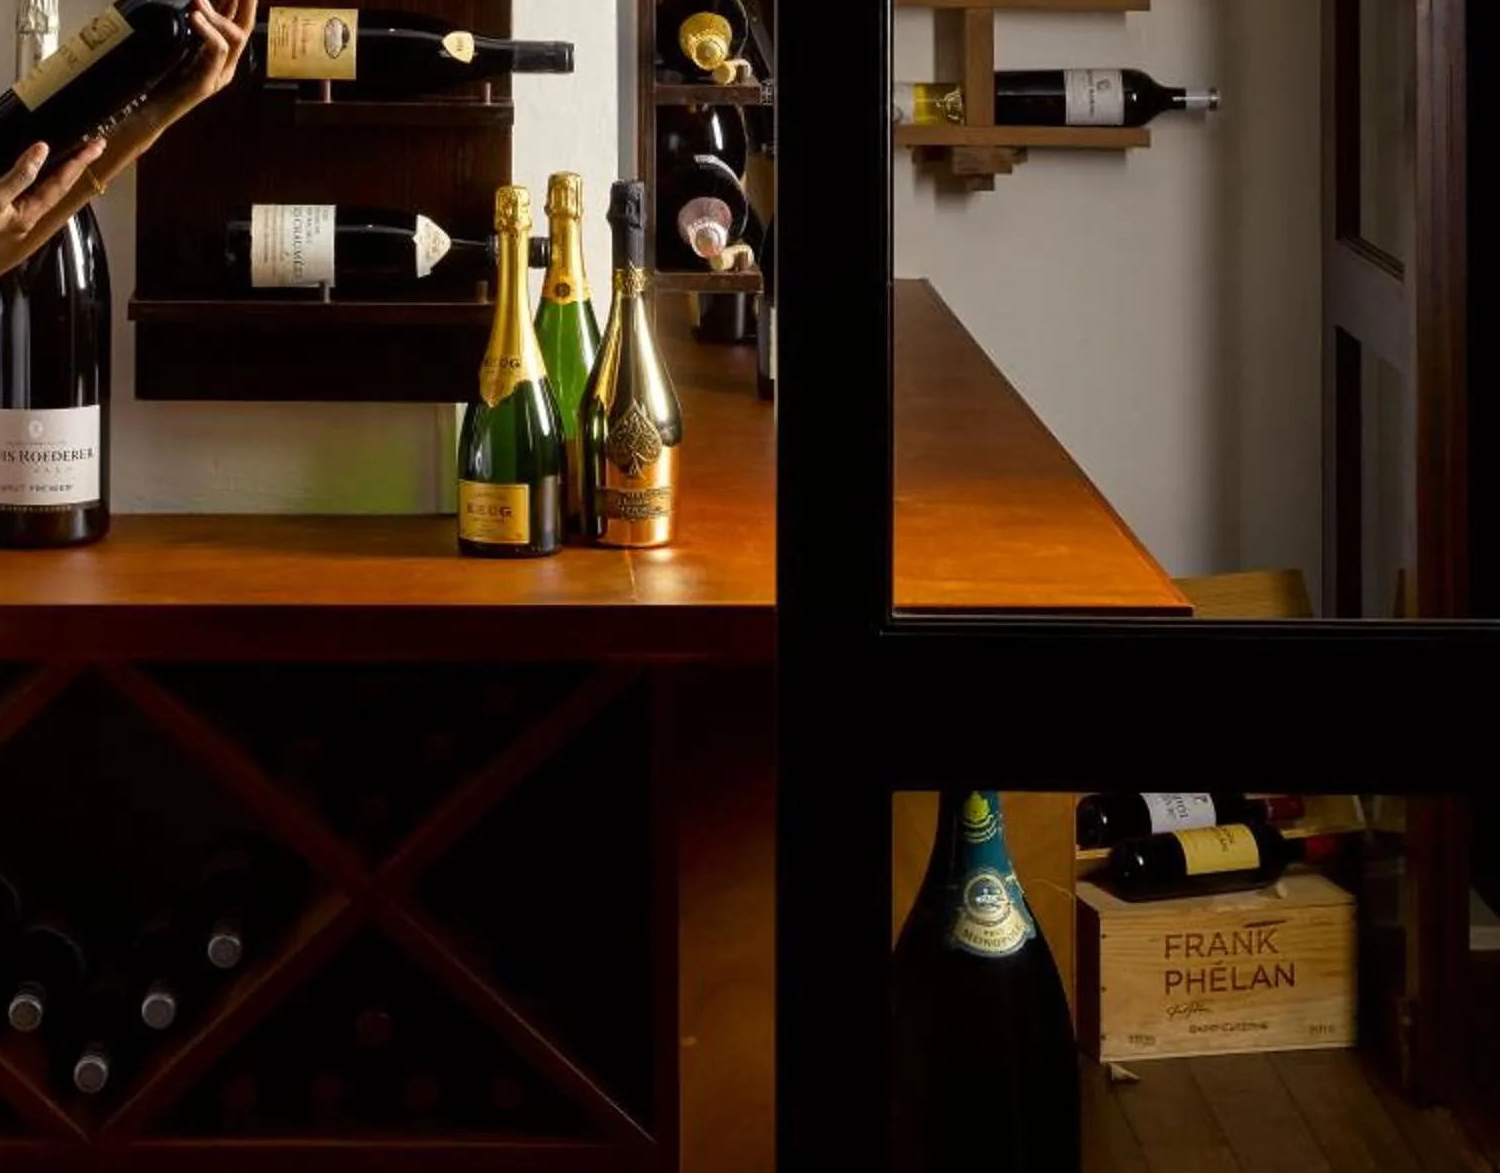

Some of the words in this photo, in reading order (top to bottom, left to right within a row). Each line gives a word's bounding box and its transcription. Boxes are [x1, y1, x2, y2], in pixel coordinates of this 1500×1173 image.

[19, 448, 94, 464] ROEDERER
[1164, 928, 1279, 960] FRANK
[1164, 959, 1296, 996] PHÉLAN
